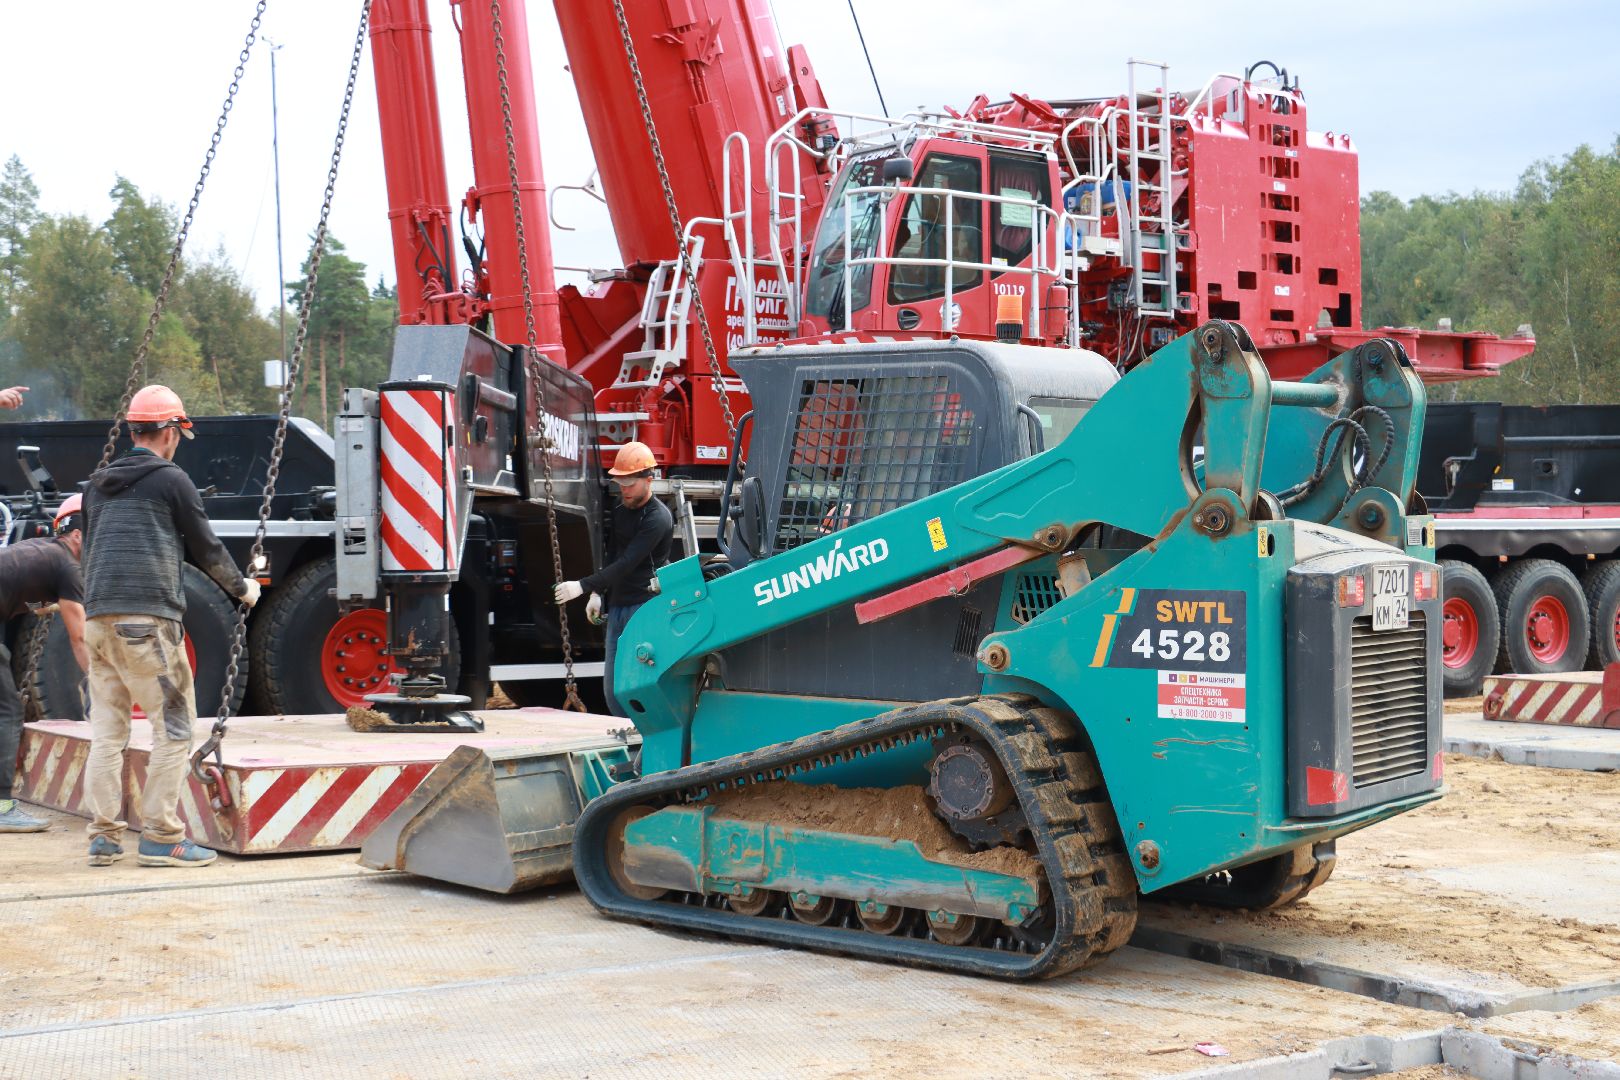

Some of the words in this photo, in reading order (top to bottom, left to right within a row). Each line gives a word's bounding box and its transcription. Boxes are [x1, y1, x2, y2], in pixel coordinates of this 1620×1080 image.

[993, 283, 1025, 296] 10119
[539, 410, 579, 461] ROSKRAN
[753, 537, 889, 607] SUNWARD
[1377, 569, 1405, 594] 7201
[1156, 599, 1233, 624] SWTL
[1395, 598, 1406, 618] 24
[1131, 628, 1231, 662] 4528
[1180, 686, 1222, 697] СПЕЦТЕХНИКА
[1199, 676, 1235, 685] МАШИНЕРИ
